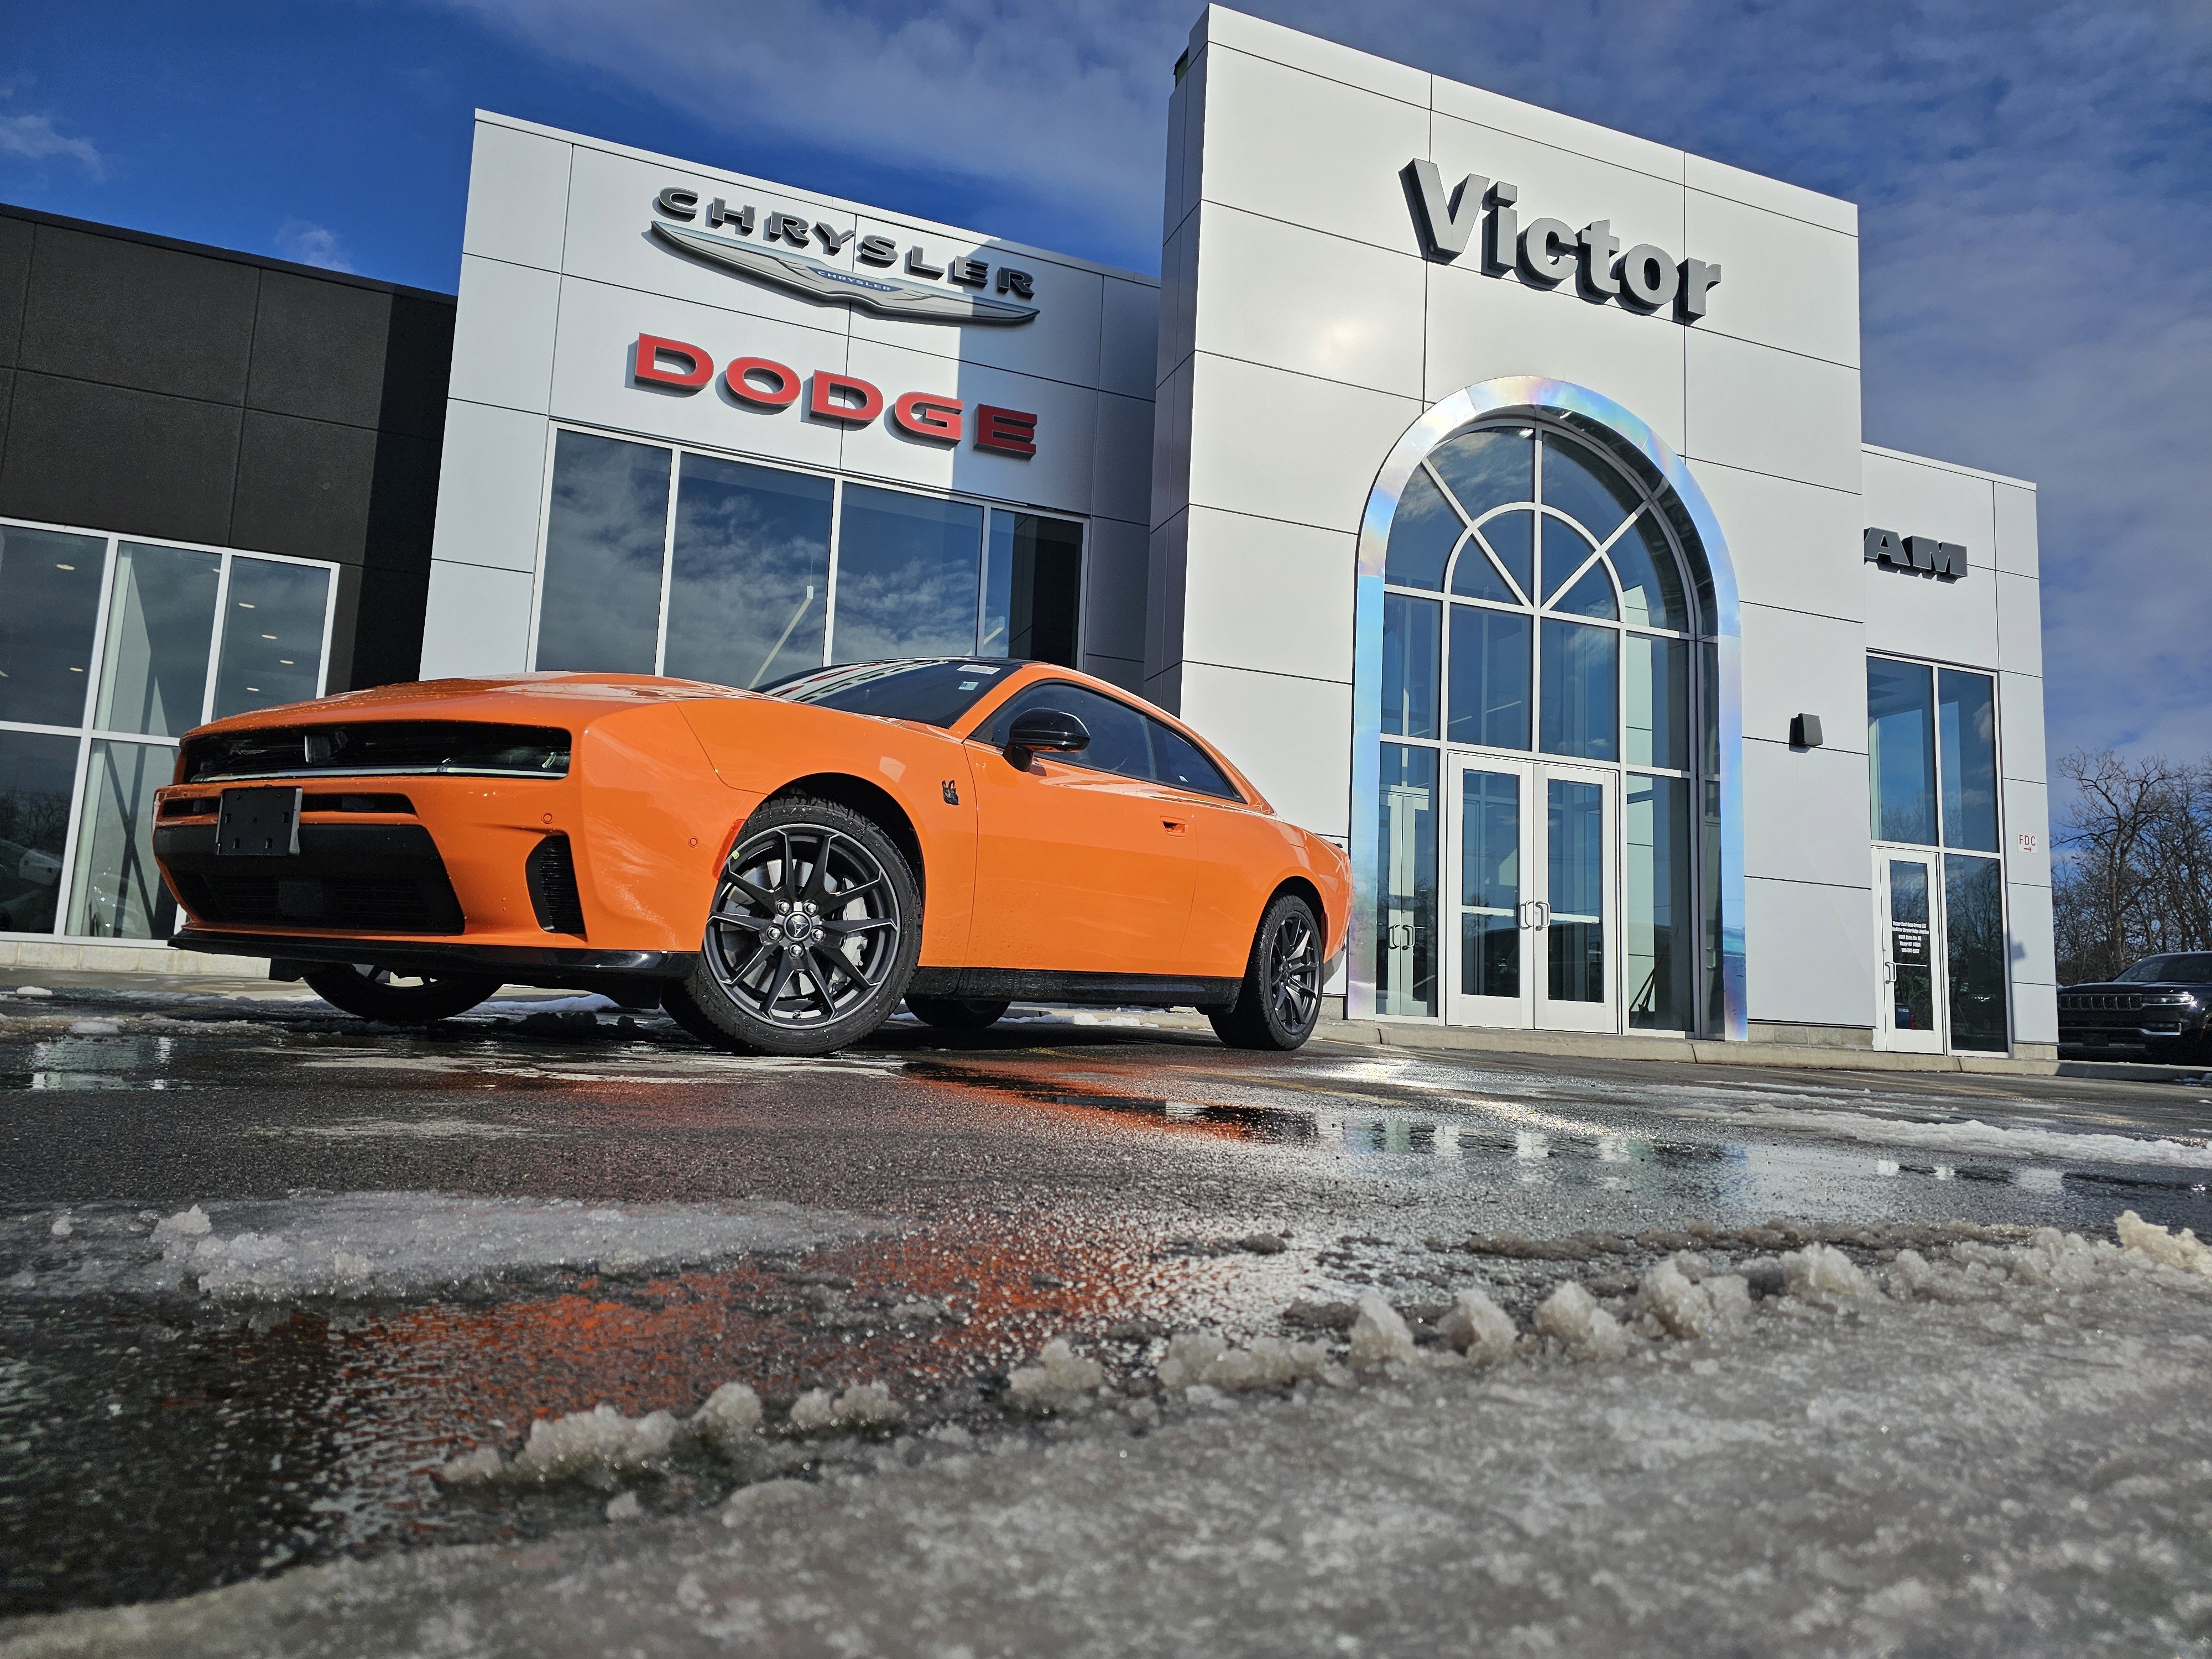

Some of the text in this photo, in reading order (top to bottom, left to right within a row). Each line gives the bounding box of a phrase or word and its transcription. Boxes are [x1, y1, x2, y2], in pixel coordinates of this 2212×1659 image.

[658, 186, 1035, 299] CHRYSLER
[817, 271, 890, 291] CHRYSLER
[1398, 158, 1721, 323] Victor
[634, 333, 1038, 460] DODGE
[1864, 527, 1968, 578] AM
[2019, 834, 2036, 846] FDC
